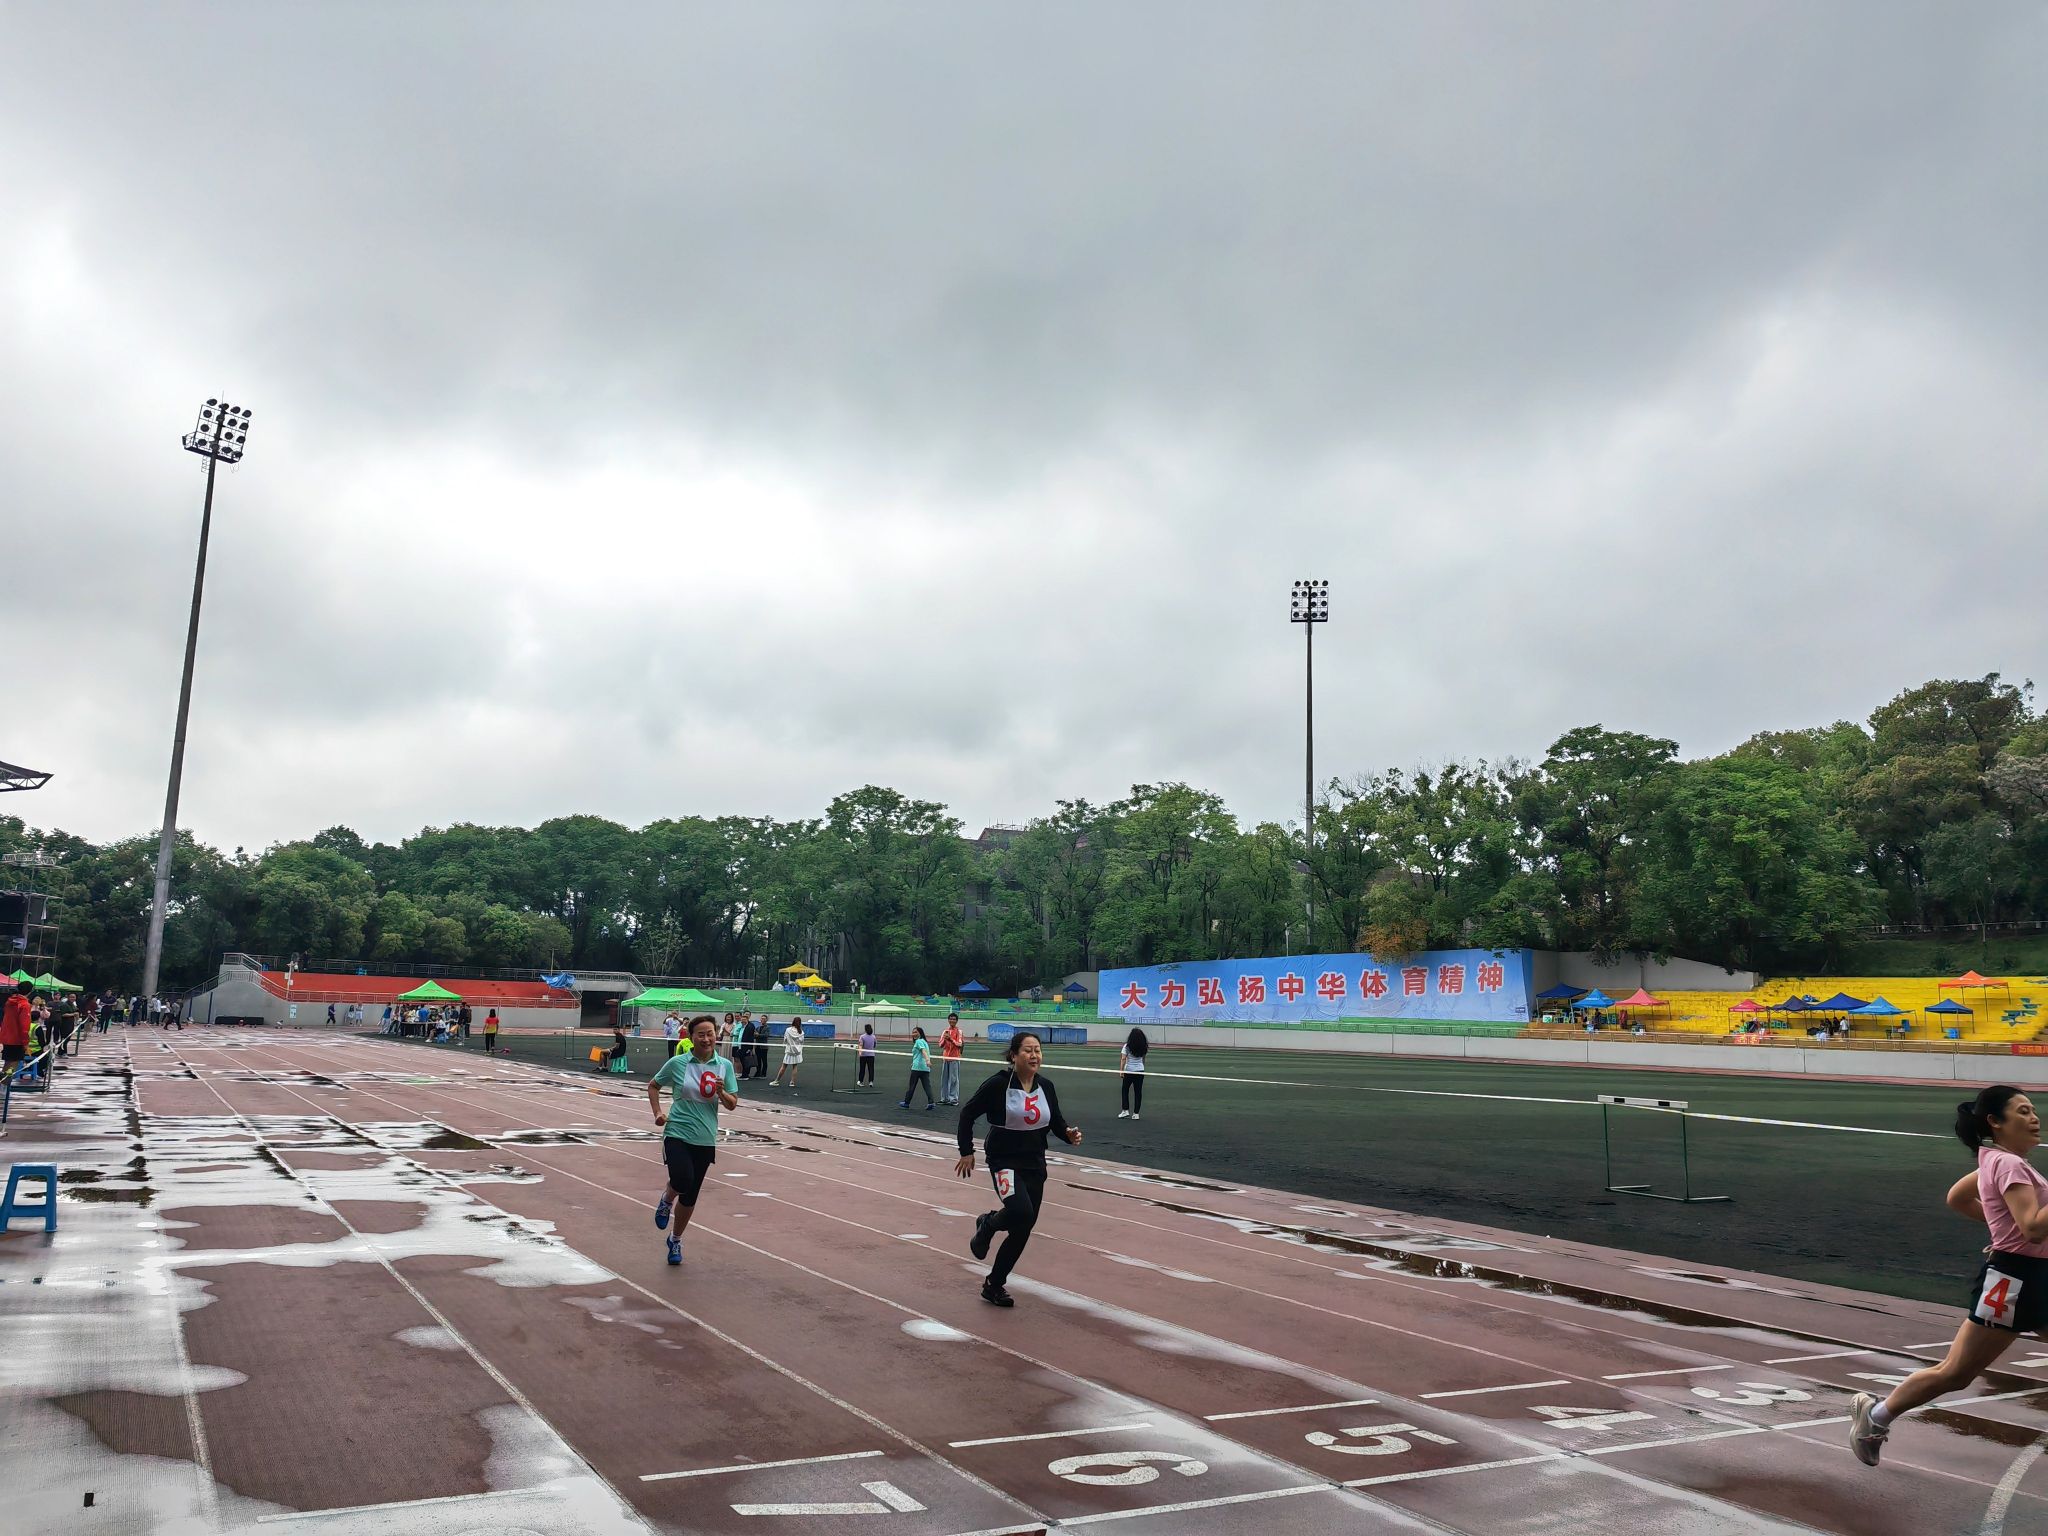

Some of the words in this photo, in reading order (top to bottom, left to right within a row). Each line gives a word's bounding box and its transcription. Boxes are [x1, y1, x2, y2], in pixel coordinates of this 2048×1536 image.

[1120, 961, 1504, 1009] 大力弘扬中华体育精神
[700, 1071, 717, 1098] 6
[1023, 1095, 1041, 1126] 5
[997, 1170, 1010, 1196] 5
[1983, 1277, 2011, 1319] 4
[1690, 1381, 1813, 1405] 3
[1526, 1405, 1657, 1431] 4
[1304, 1422, 1460, 1456] 5
[1048, 1451, 1208, 1486] 6
